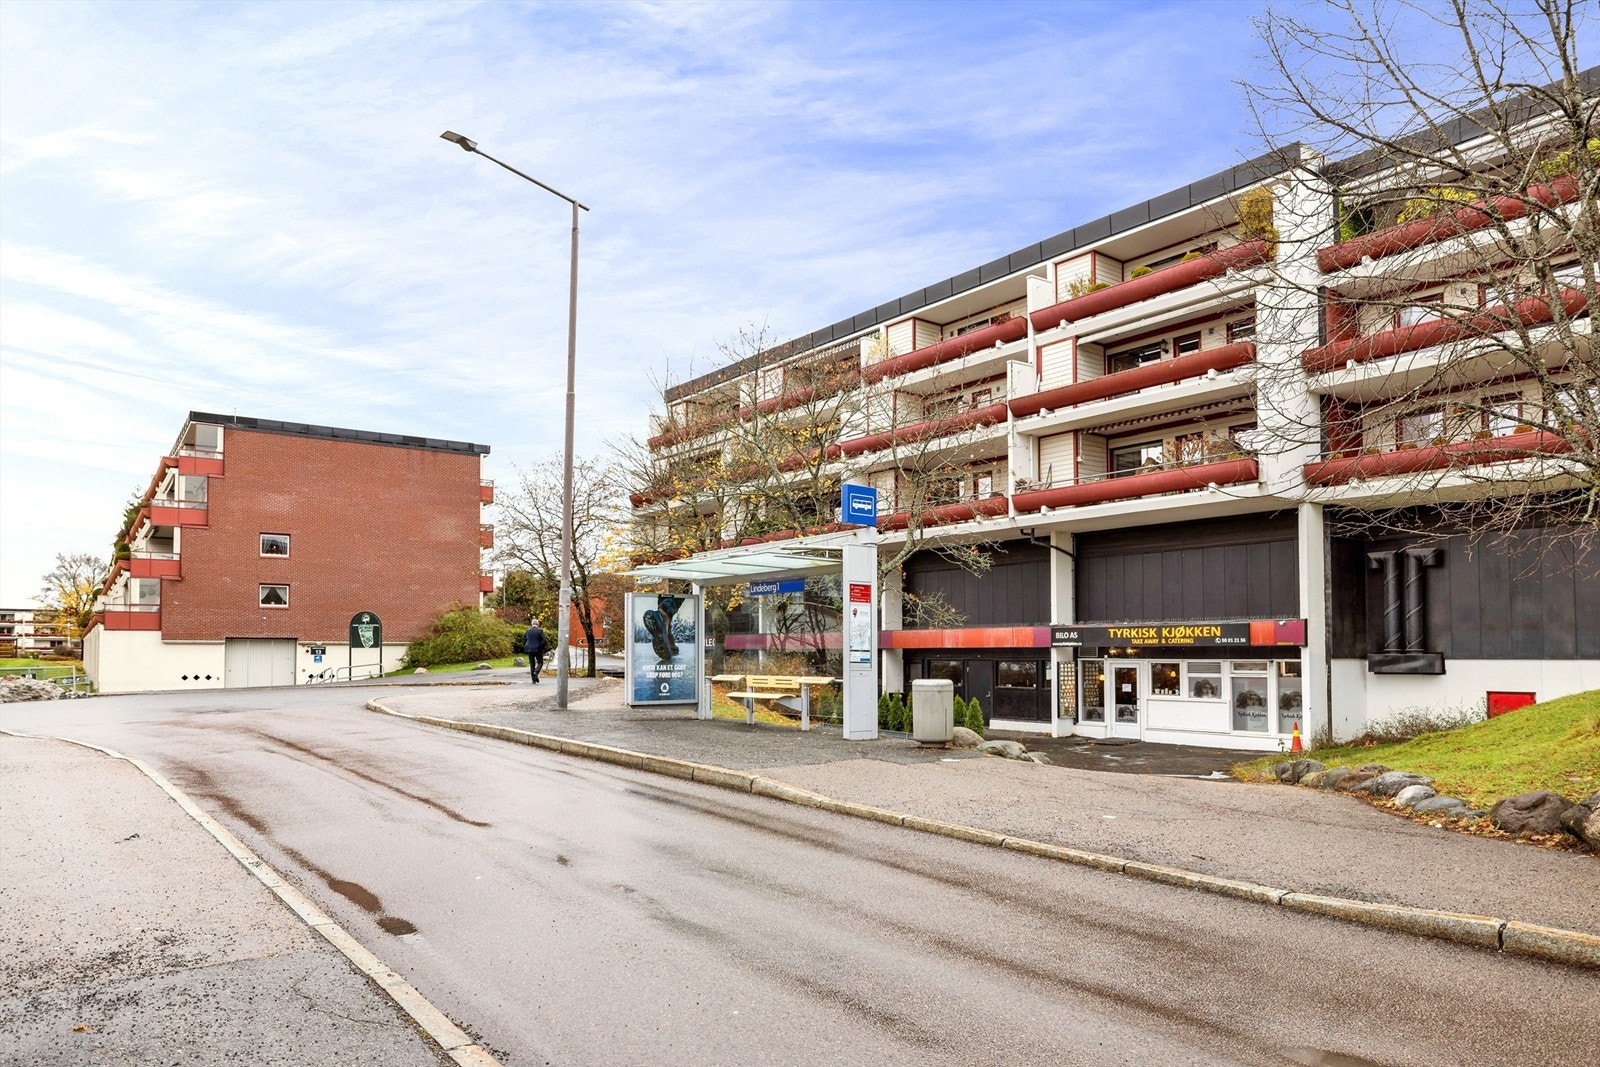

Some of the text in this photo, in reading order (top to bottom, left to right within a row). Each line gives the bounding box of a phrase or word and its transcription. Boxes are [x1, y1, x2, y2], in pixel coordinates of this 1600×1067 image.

[750, 583, 777, 593] Lindeberg
[1108, 626, 1221, 639] TYRKISK KJØKKEN
